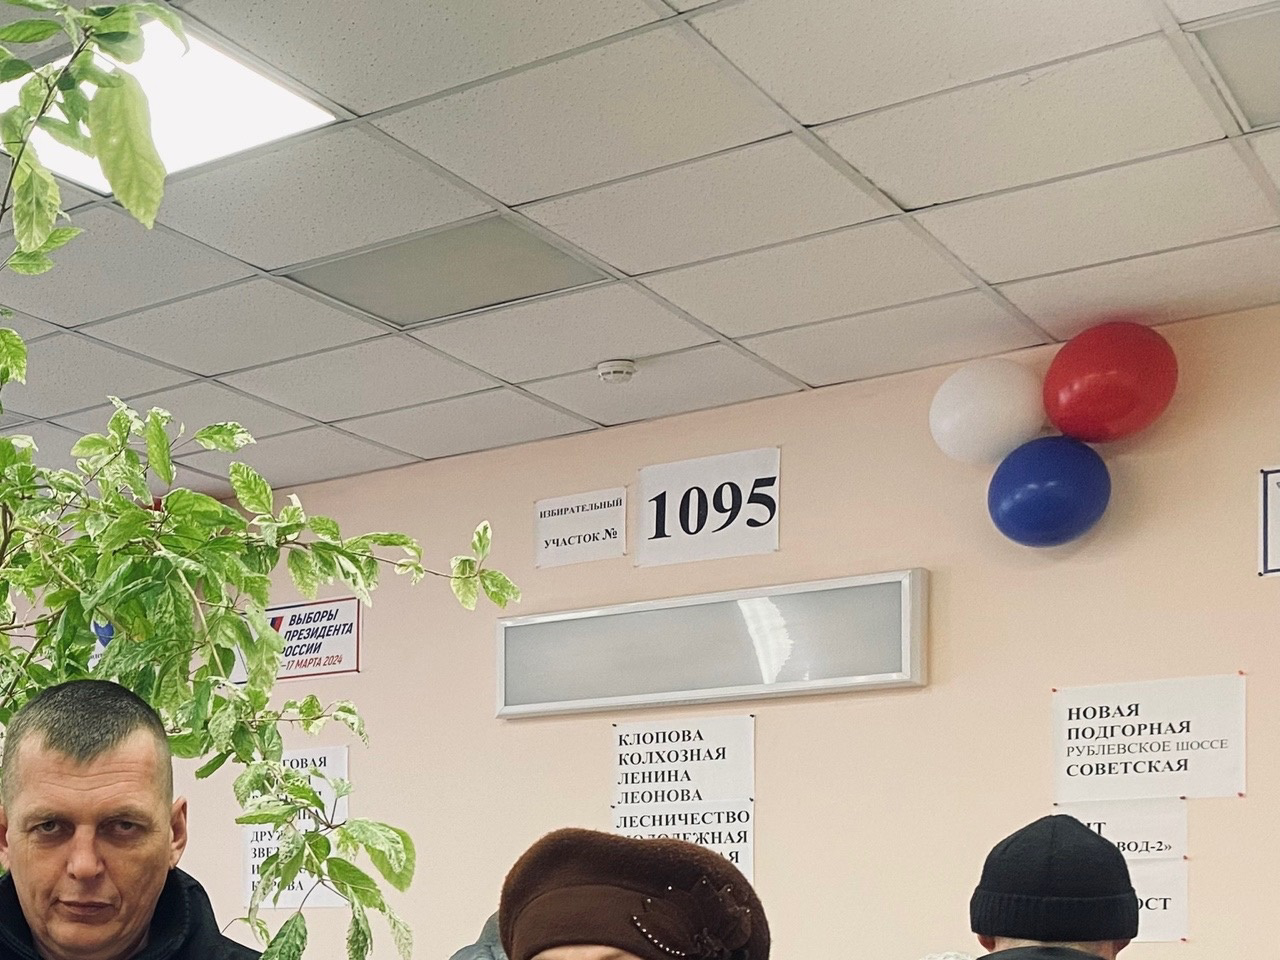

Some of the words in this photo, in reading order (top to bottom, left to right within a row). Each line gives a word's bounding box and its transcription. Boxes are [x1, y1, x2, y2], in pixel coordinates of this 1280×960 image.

[539, 497, 623, 519] ИЗБИРАТЕЛЬНЫЙ
[647, 476, 777, 540] 1095
[544, 532, 601, 549] УЧАСТОК
[602, 527, 618, 540] №
[288, 608, 340, 627] ВЫБОРЫ
[284, 622, 354, 642] ПРЕЗИДЕНТА
[295, 656, 322, 669] МАРТА
[322, 654, 343, 667] 2024
[1067, 703, 1141, 721] НОВАЯ
[618, 729, 704, 747] КЛОПОВА
[1067, 720, 1192, 741] ПОДГОРНАЯ
[618, 747, 727, 766] КОЛХОЗНАЯ
[1066, 741, 1172, 757] РУБЛЕВСКОЕ
[1175, 738, 1229, 752] ШОССЕ
[617, 769, 692, 785] ЛЕНИНА
[1066, 758, 1190, 778] СОВЕТСКАЯ
[617, 788, 703, 805] ЛЕОНОВА
[616, 810, 751, 829] ЛЕСНИЧЕСТВО
[1117, 840, 1172, 853] ВОД-2»
